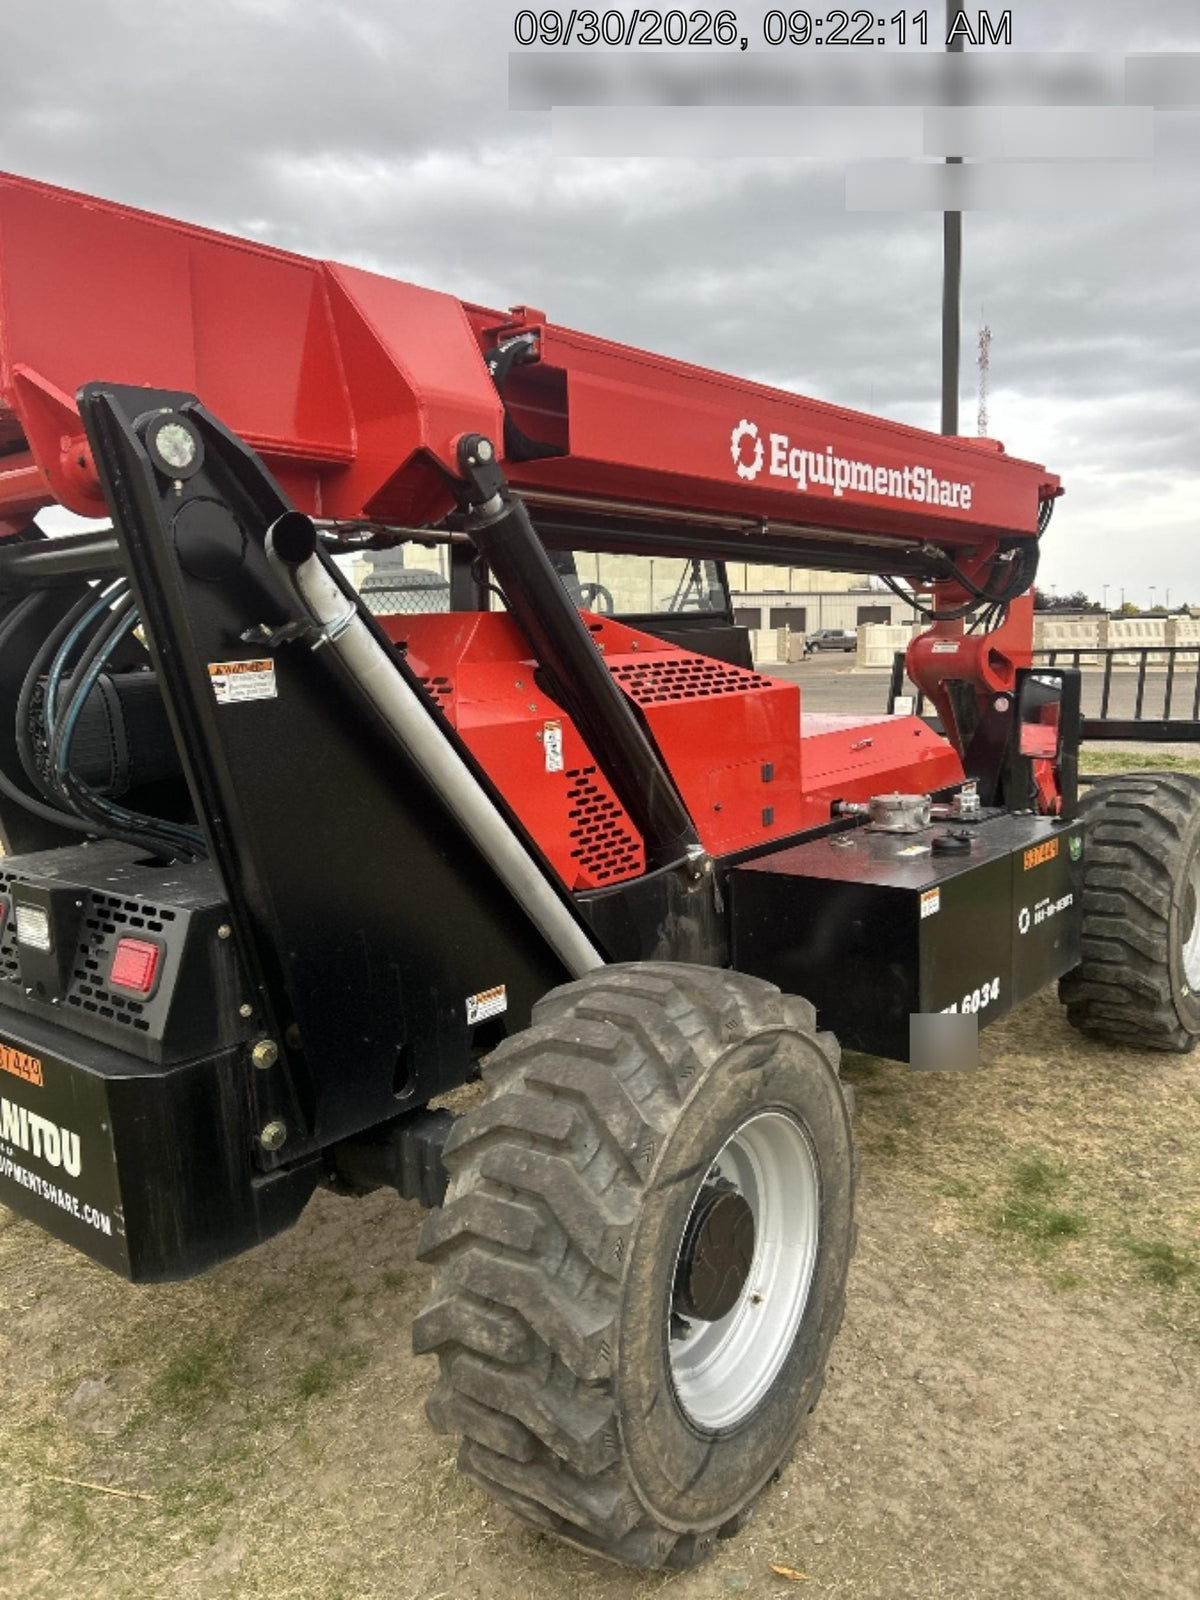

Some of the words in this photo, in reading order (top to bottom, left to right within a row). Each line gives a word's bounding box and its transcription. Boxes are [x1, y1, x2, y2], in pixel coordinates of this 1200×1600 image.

[769, 433, 972, 510] EquipmentShare
[961, 976, 1000, 1014] 6034
[0, 1097, 81, 1178] NITOU
